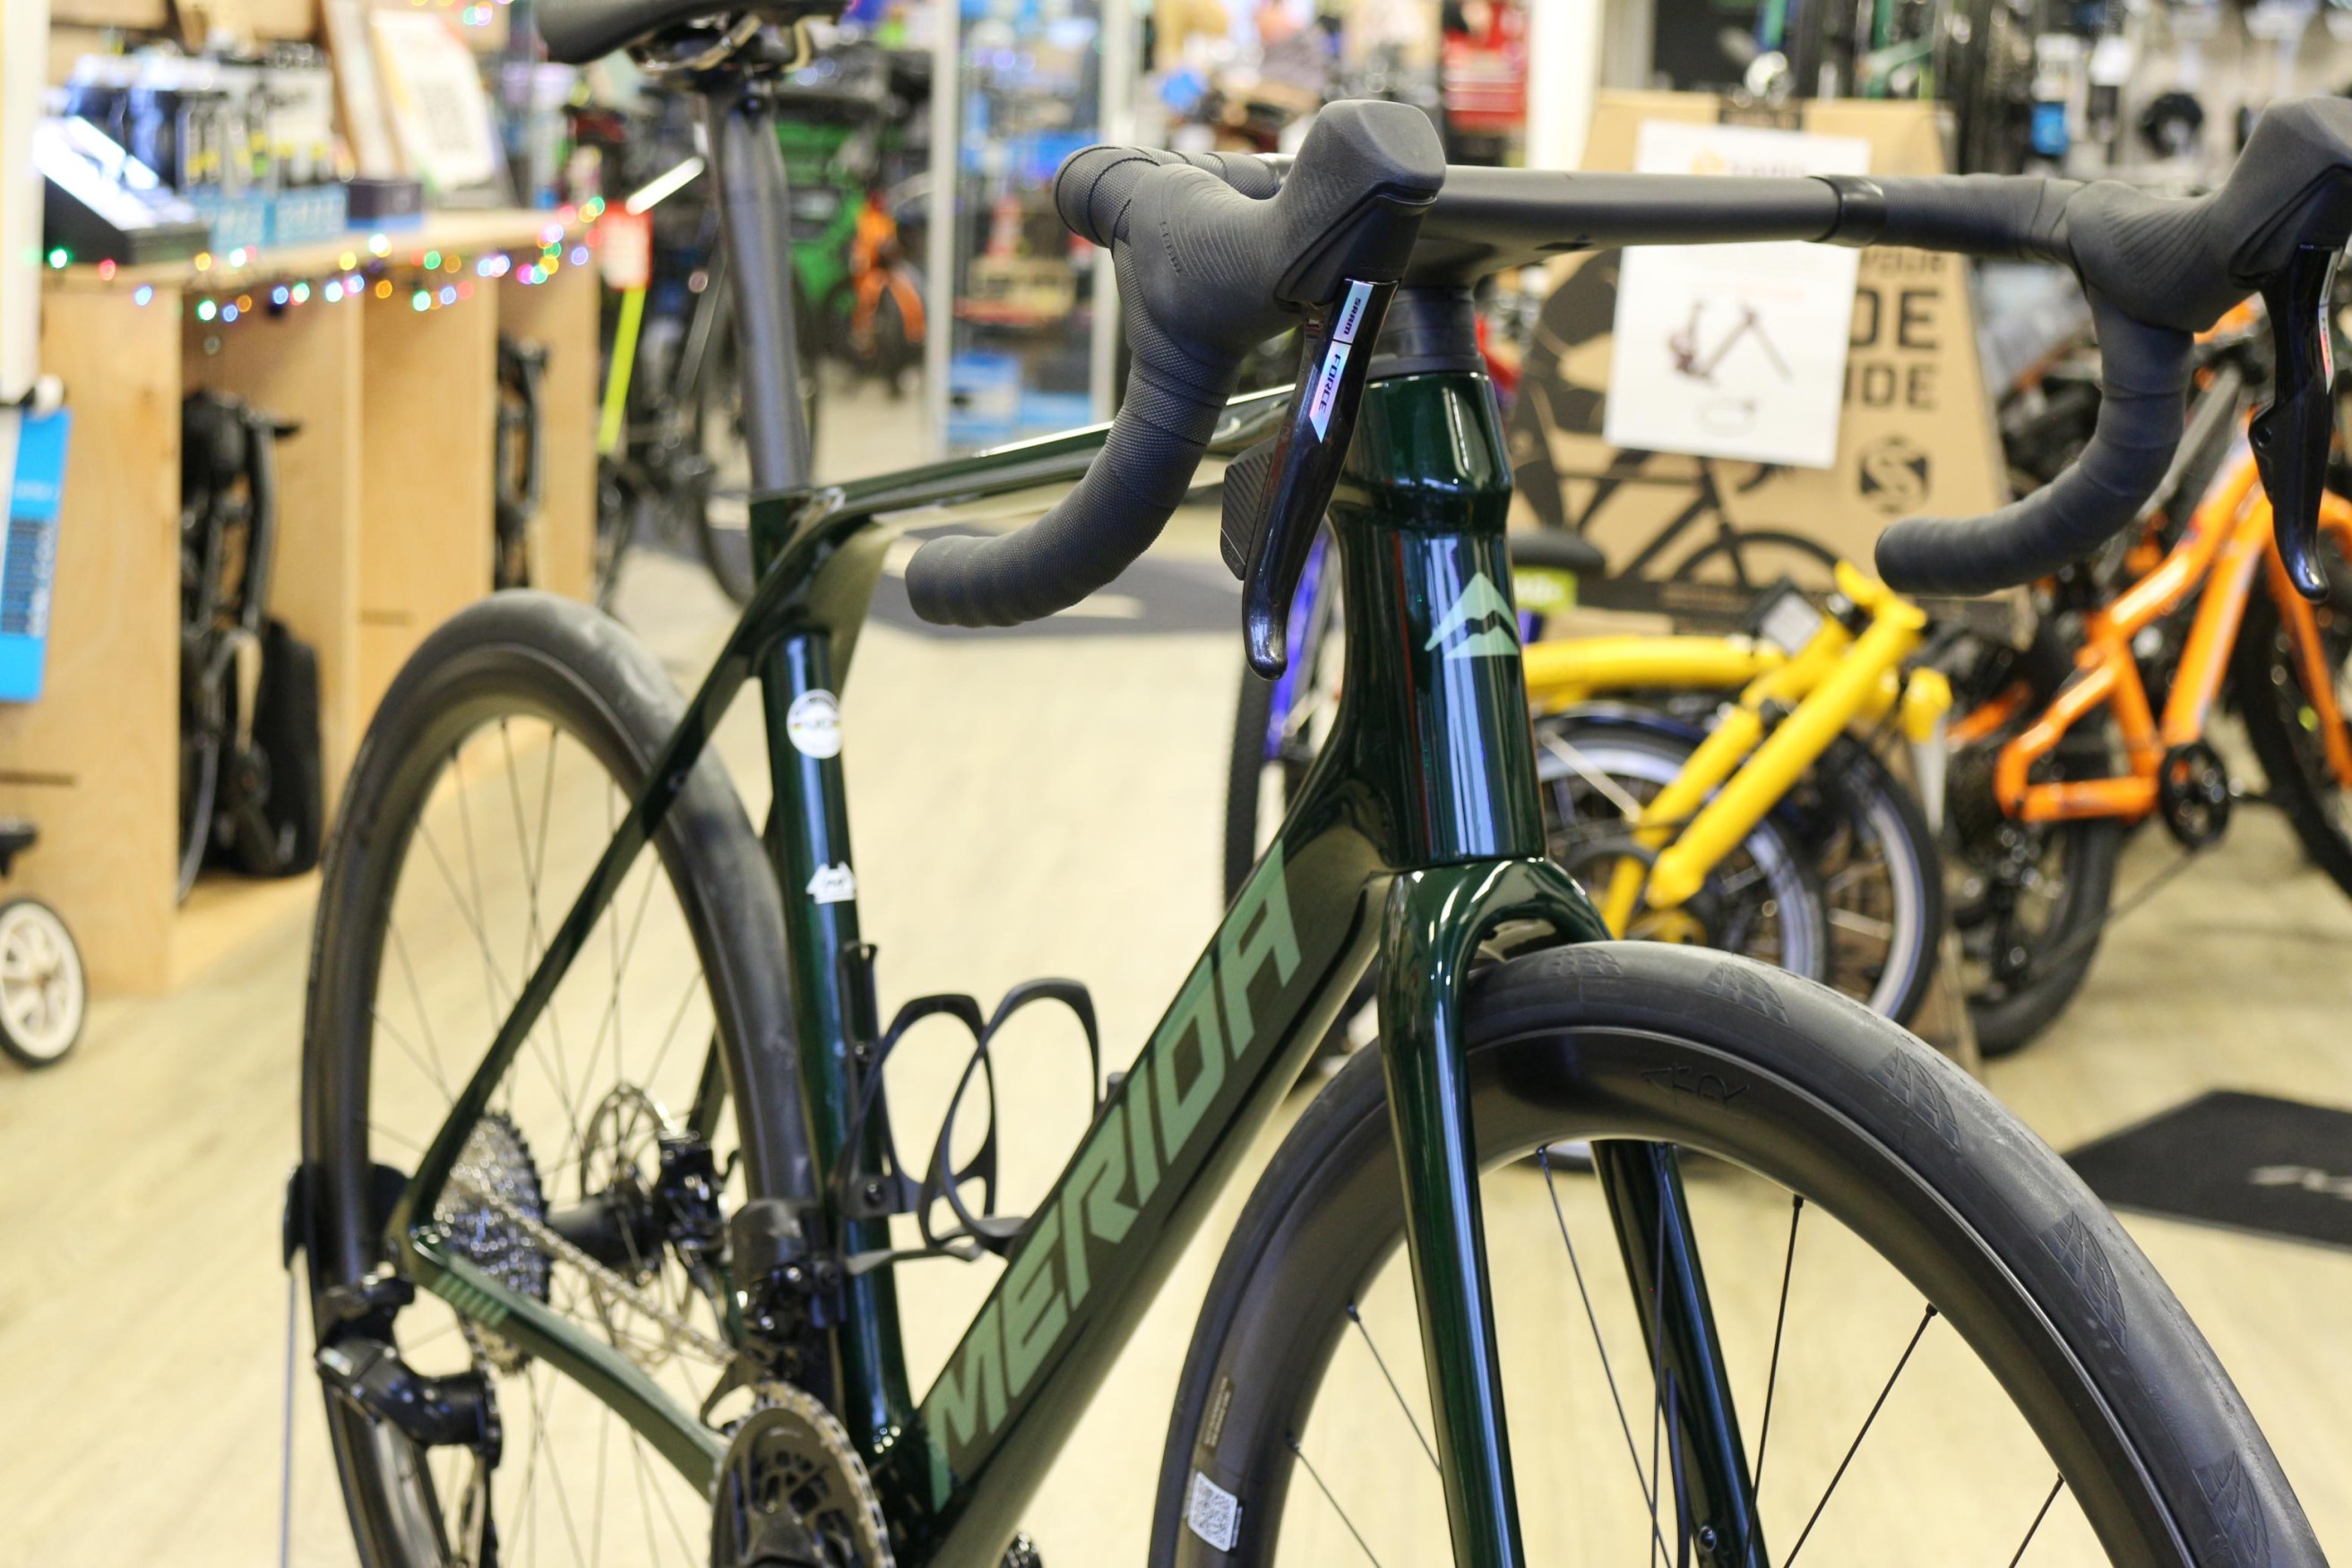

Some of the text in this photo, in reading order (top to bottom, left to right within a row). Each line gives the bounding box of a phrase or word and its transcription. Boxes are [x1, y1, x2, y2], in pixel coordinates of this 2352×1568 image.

[1344, 297, 1361, 335] SRAM
[1319, 353, 1342, 412] FORCE
[926, 838, 1302, 1514] MERIDA
